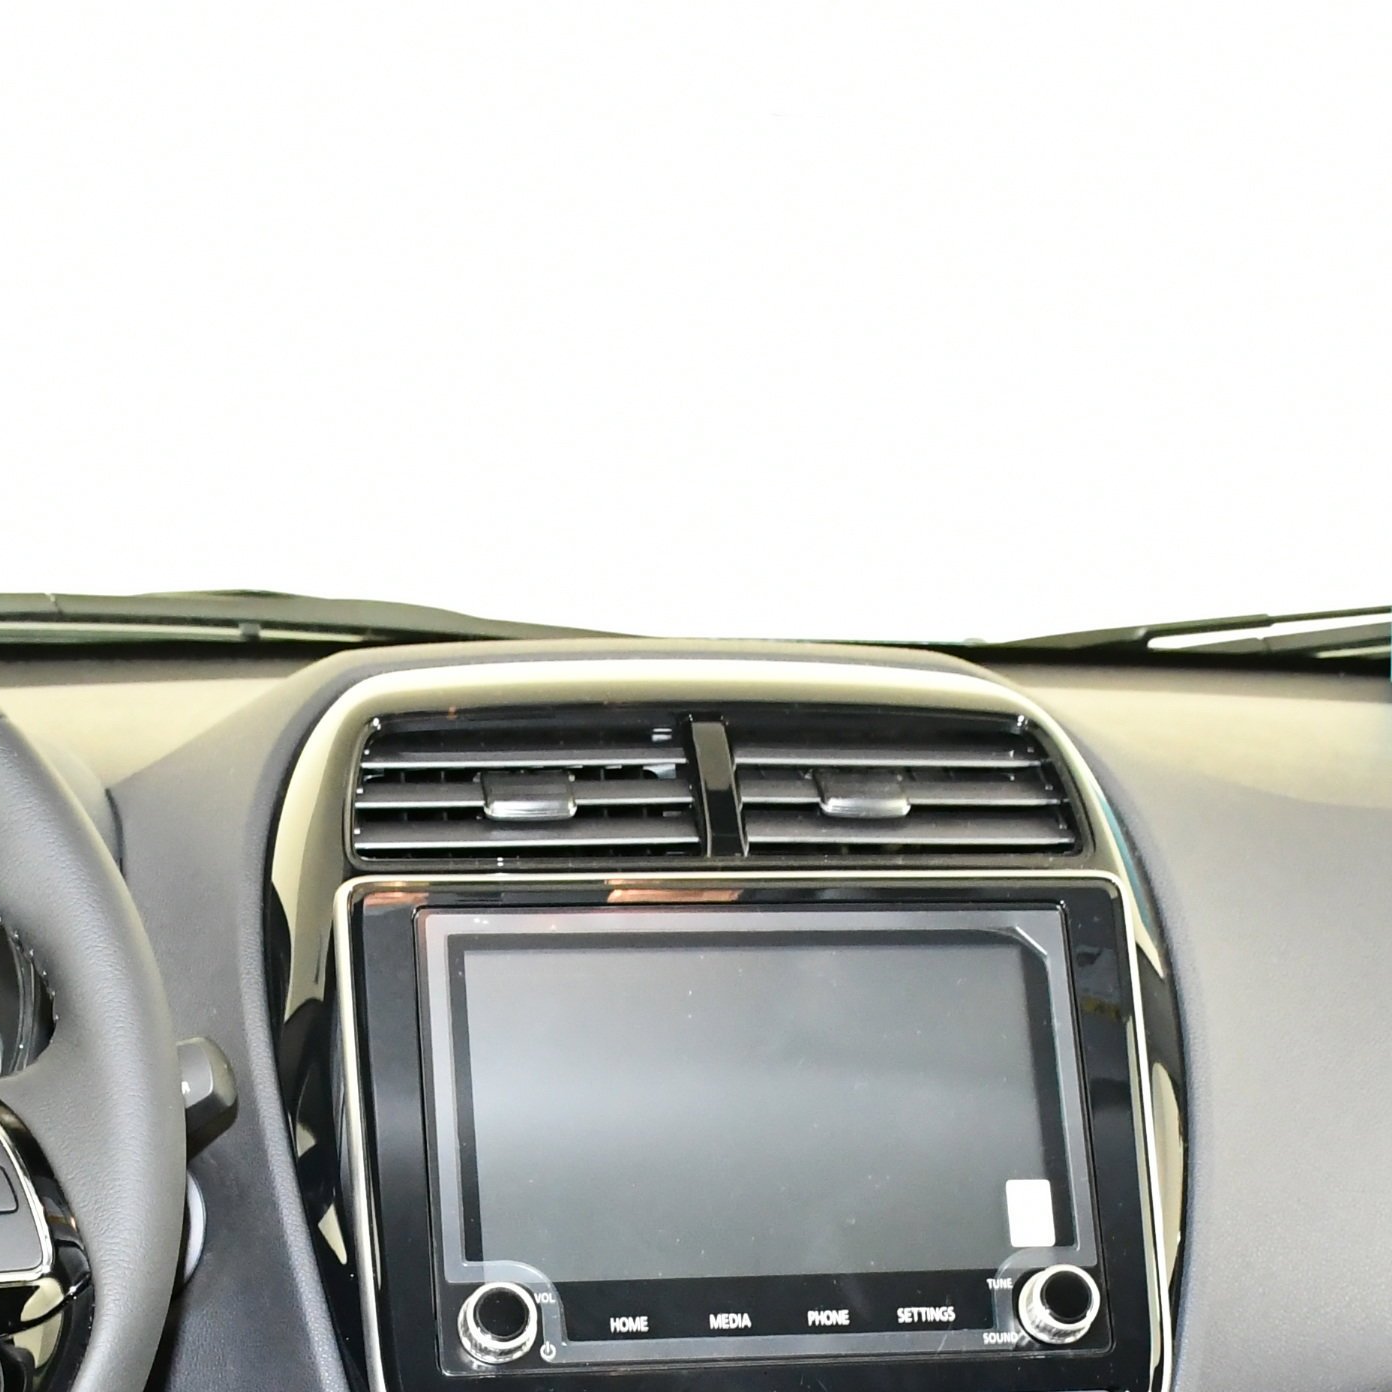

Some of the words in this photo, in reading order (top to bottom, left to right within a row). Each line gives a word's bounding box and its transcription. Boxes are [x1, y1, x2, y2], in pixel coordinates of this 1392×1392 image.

[986, 1278, 1013, 1290] TUNE
[534, 1292, 555, 1304] VOL
[709, 1313, 752, 1330] MEDIA
[807, 1309, 850, 1326] PHONE
[897, 1306, 956, 1324] SETTINGS
[610, 1316, 649, 1333] HOME
[983, 1331, 1018, 1345] SOUND
